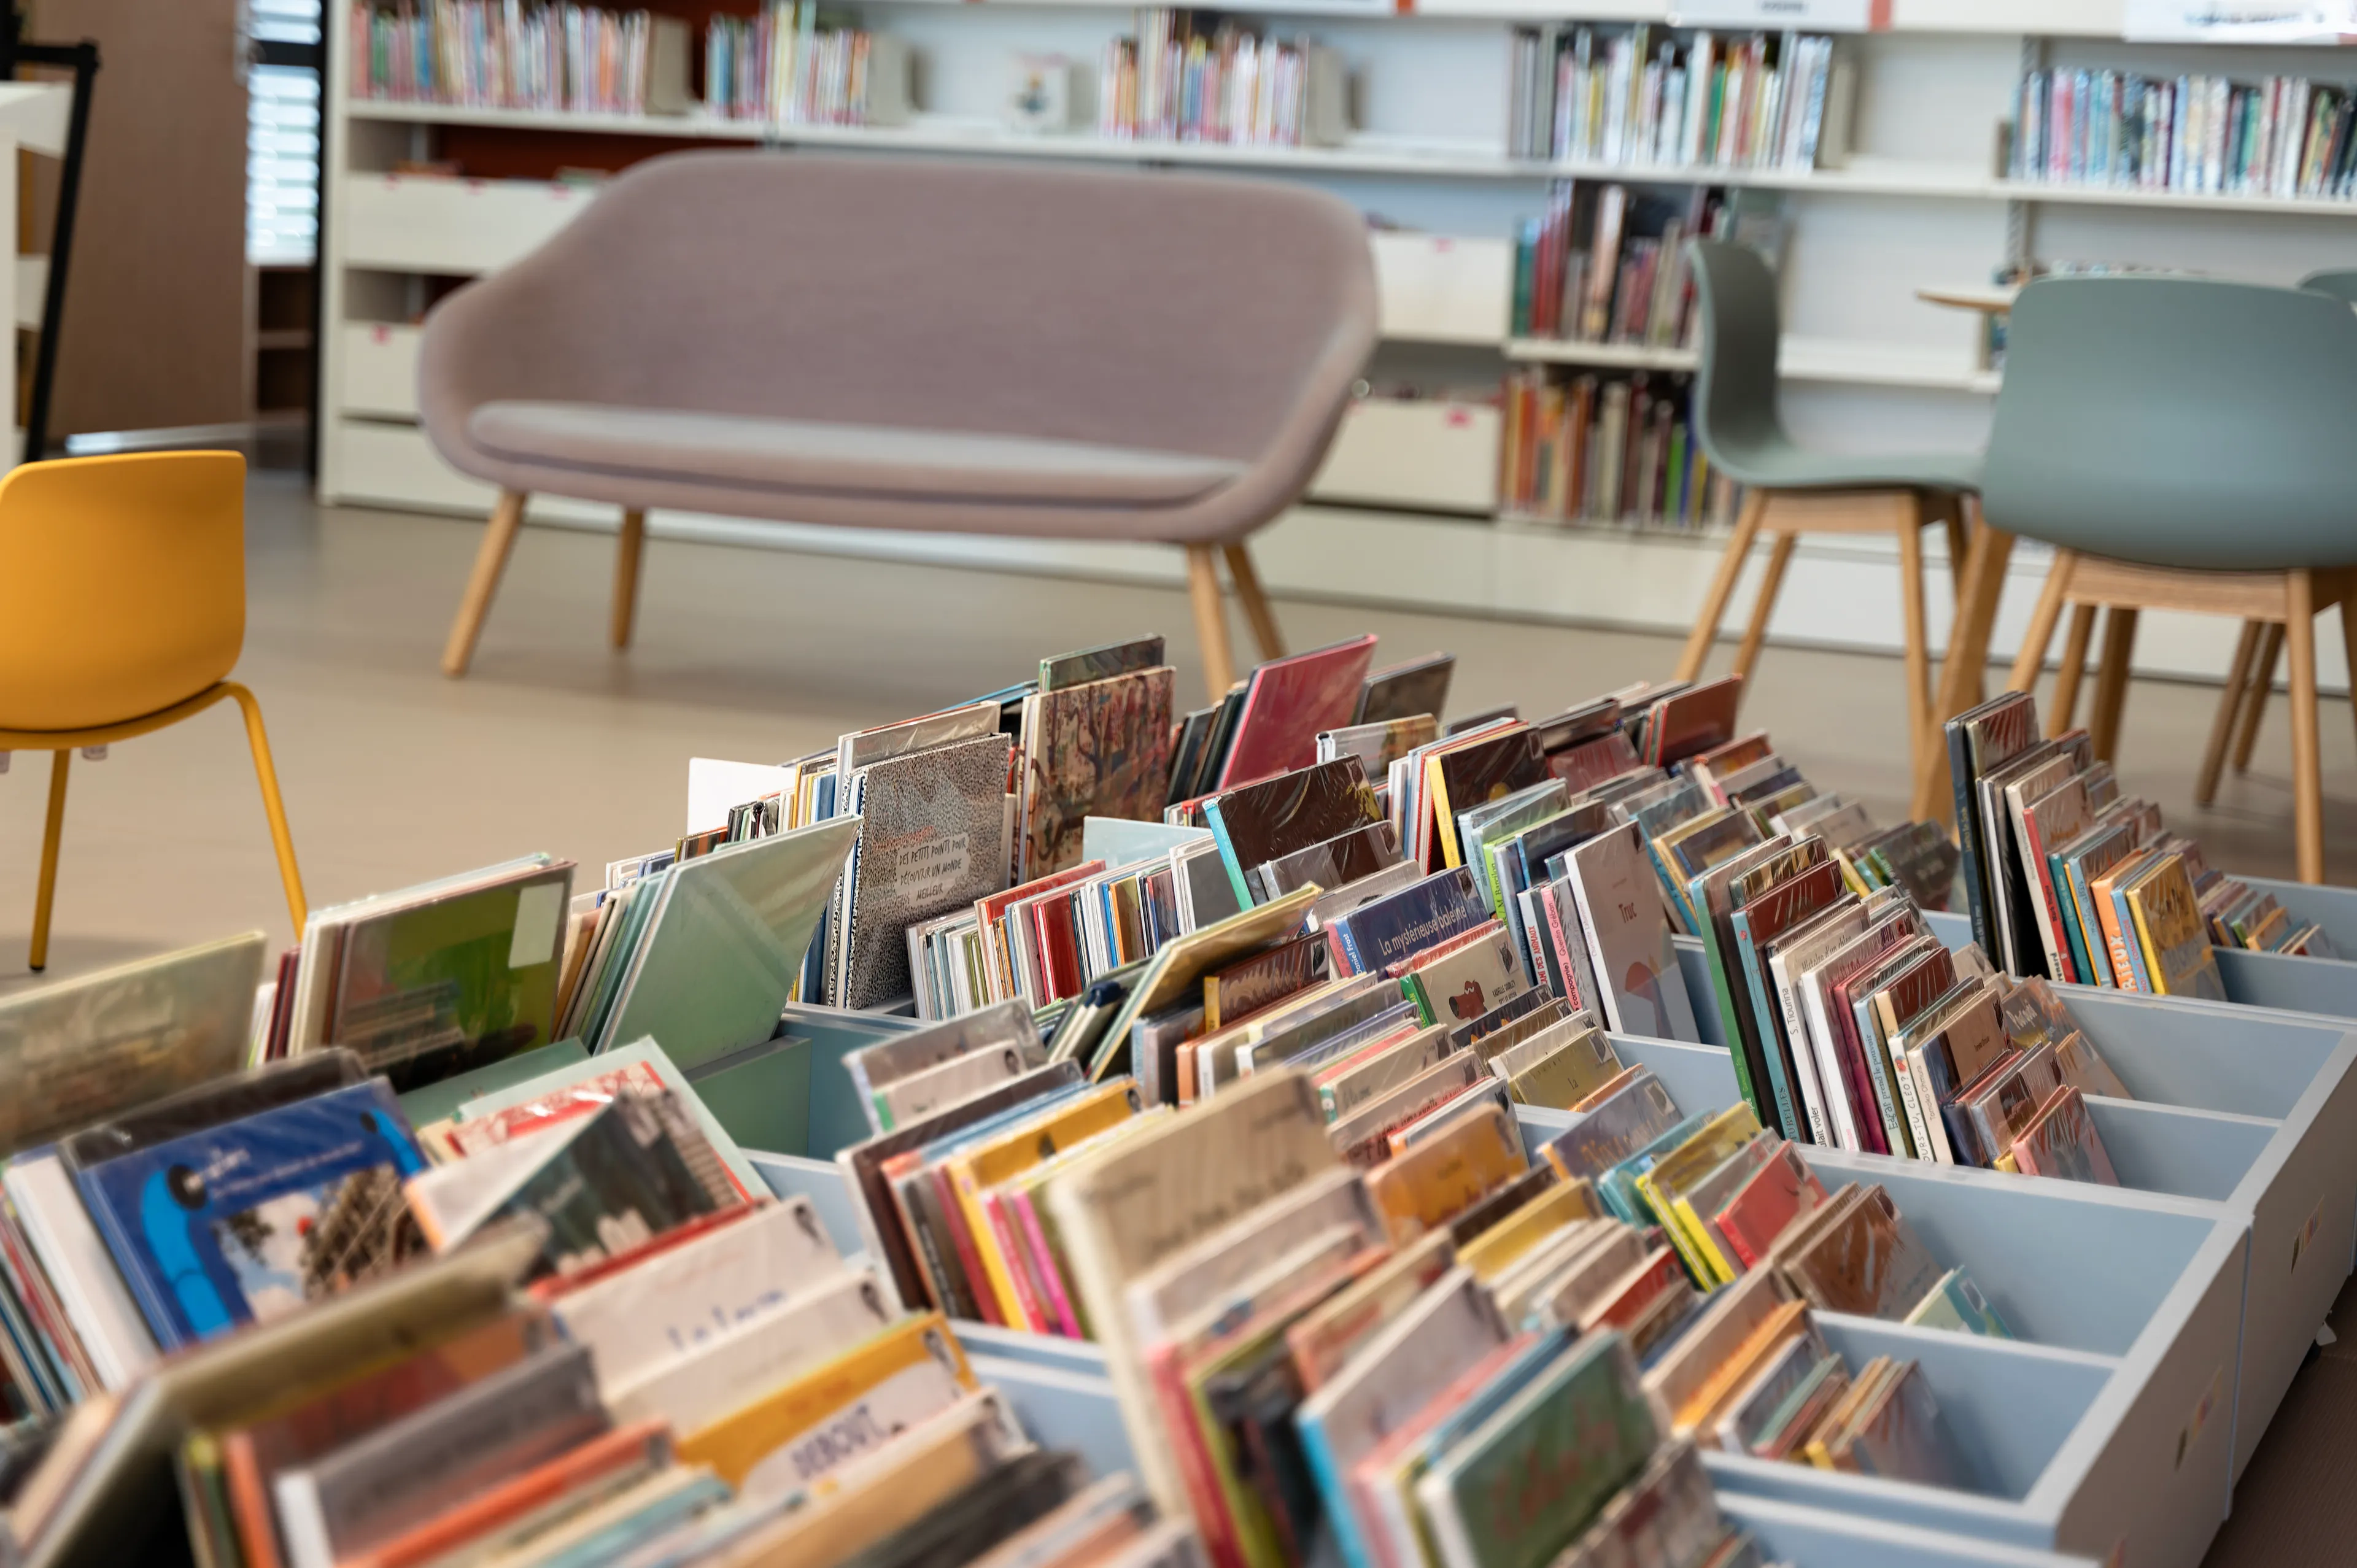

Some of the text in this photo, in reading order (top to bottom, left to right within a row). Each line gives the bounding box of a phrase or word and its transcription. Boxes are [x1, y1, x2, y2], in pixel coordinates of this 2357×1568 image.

[899, 837, 966, 866] DES PETITS POINTS POUR
[900, 859, 962, 886] DÉCOUVRIR UN MONDE
[1491, 863, 1502, 896] Barcilon
[916, 882, 943, 901] MEILLEUR
[1618, 902, 1637, 924] Truc
[1378, 904, 1467, 956] La mystérieuse baleine
[1342, 933, 1363, 976] Daniel Frost
[1536, 956, 1544, 970] DES
[1549, 903, 1579, 1005] compagnie) Quentin Gréban
[2050, 952, 2063, 982] renard
[1782, 988, 1799, 1035] S. Tiourina
[1568, 1078, 1579, 1090] La
[1867, 1034, 1898, 1130] Edgar prend le pouvoir
[1903, 1084, 1916, 1108] CLÉO
[1916, 1065, 1937, 1121] Tomoko Ohmura
[1811, 1106, 1821, 1128] voler
